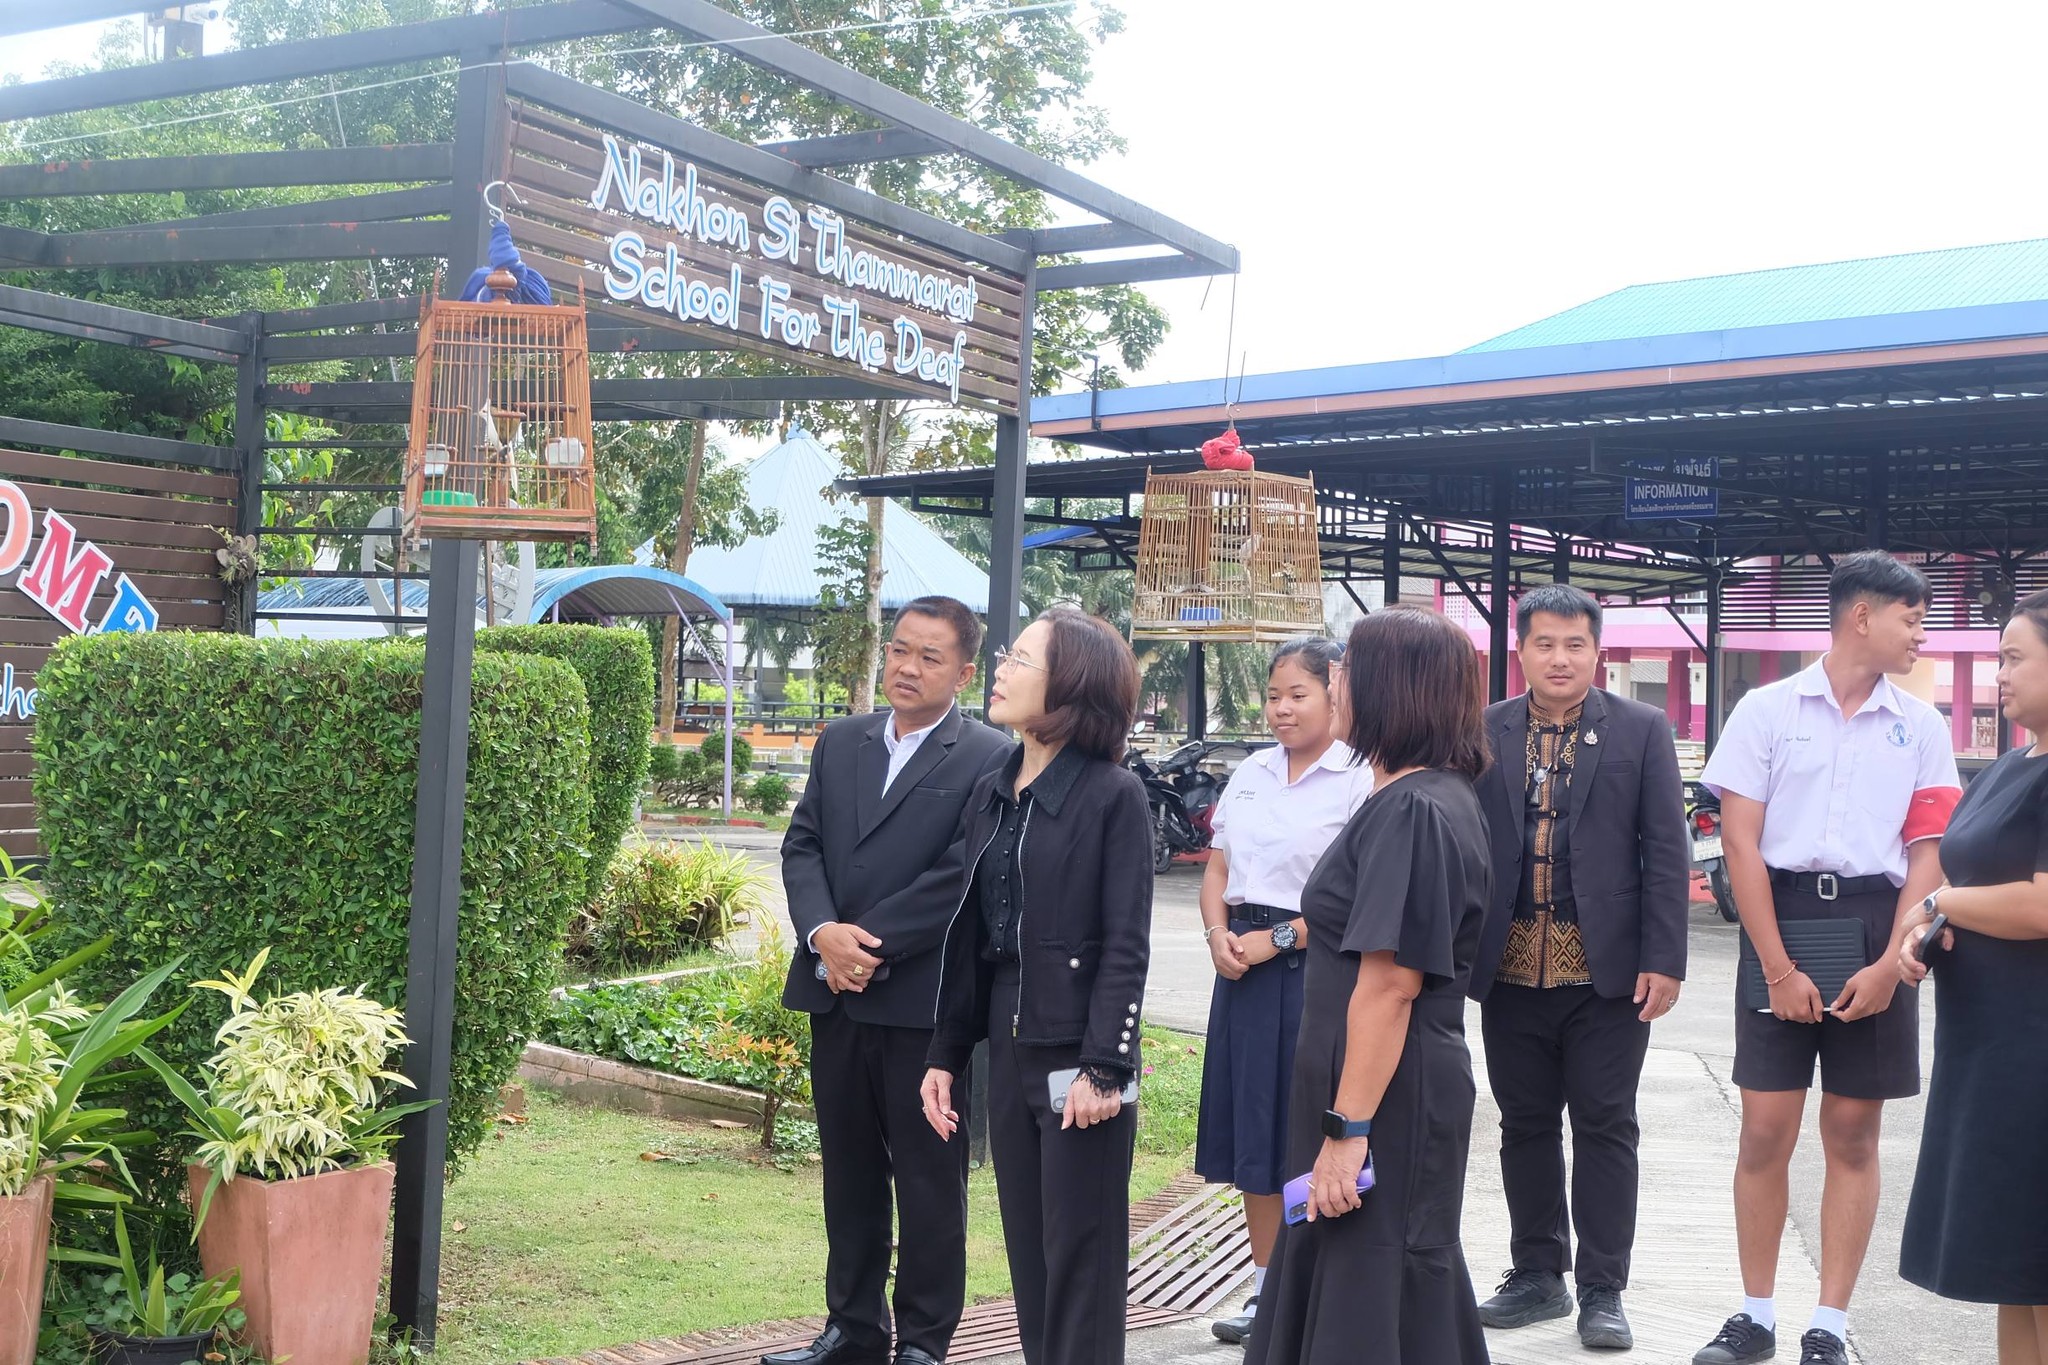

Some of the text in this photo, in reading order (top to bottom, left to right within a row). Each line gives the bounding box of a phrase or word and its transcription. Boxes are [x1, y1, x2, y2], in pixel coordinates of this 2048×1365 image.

[592, 134, 978, 322] Nakhon Si Thammarat
[604, 230, 967, 403] School For The Deaf
[1634, 484, 1709, 500] INFORMATION
